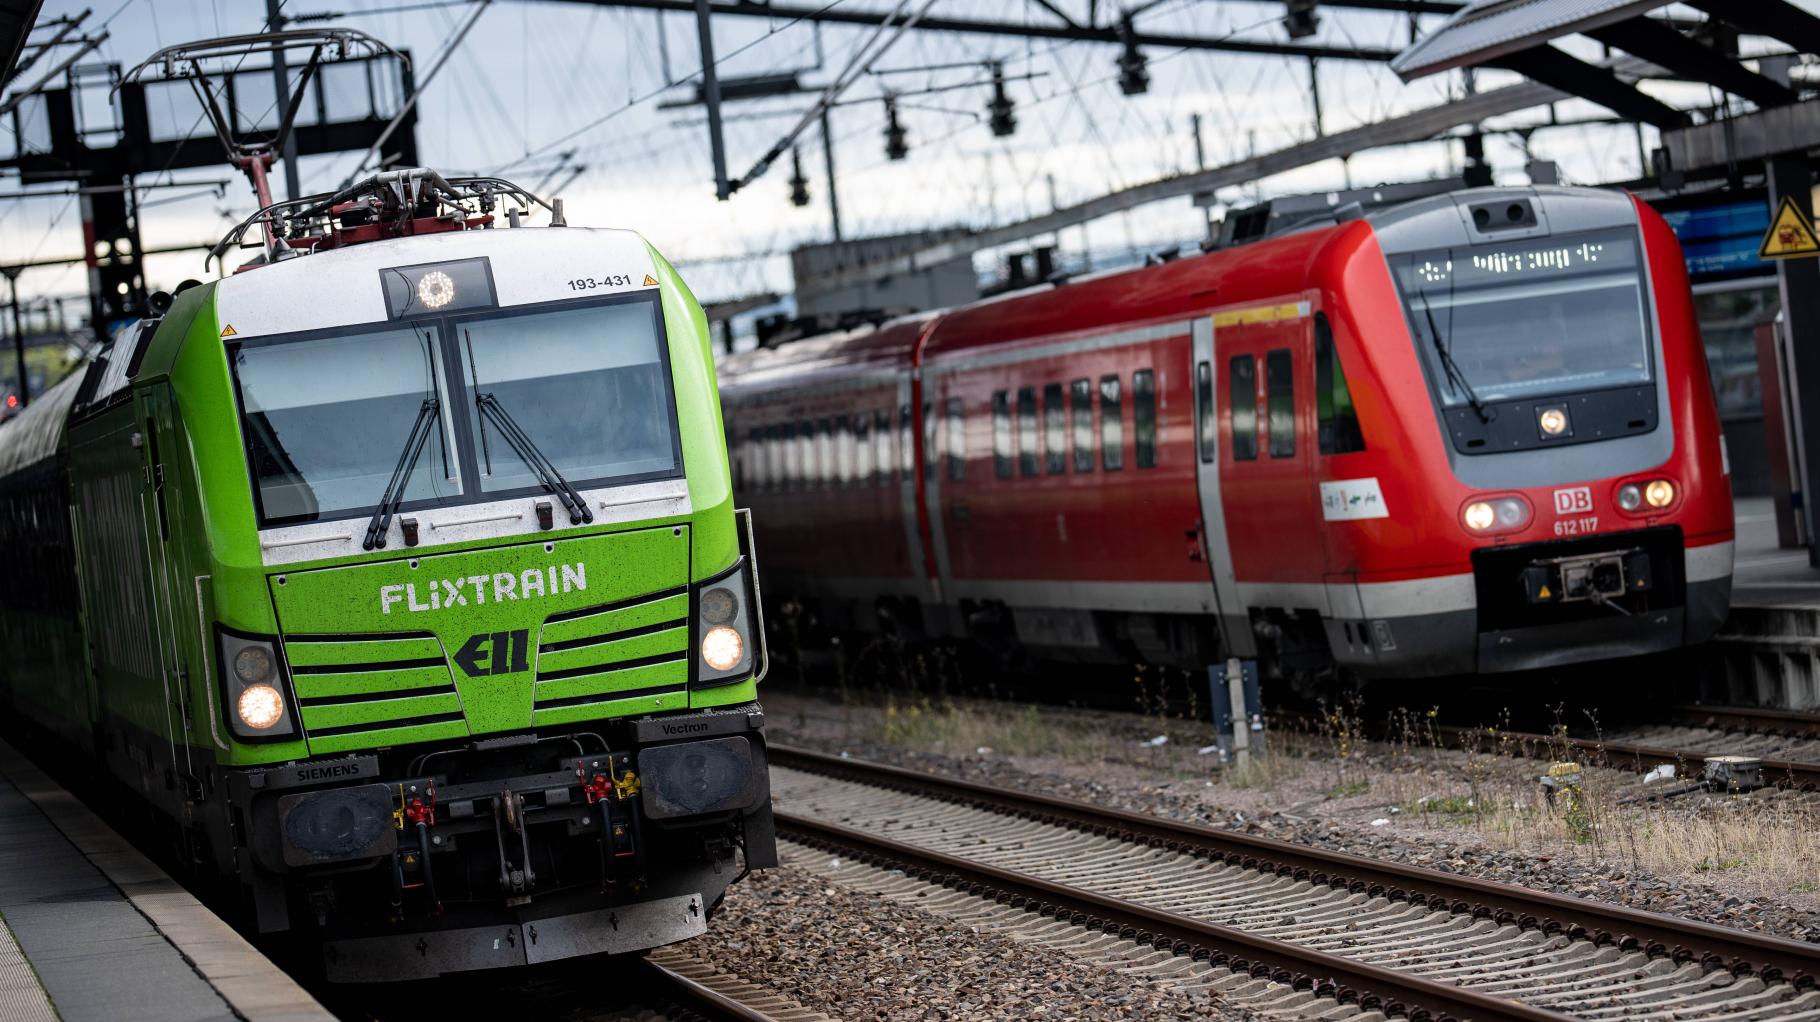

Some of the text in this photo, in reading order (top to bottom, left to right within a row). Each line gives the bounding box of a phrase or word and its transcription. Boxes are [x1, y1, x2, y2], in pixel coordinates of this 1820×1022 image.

[567, 274, 631, 291] 193-431
[1558, 490, 1589, 511] DB
[1554, 517, 1598, 536] 612 117
[662, 722, 709, 735] Vectron
[297, 763, 360, 781] SIEMENS
